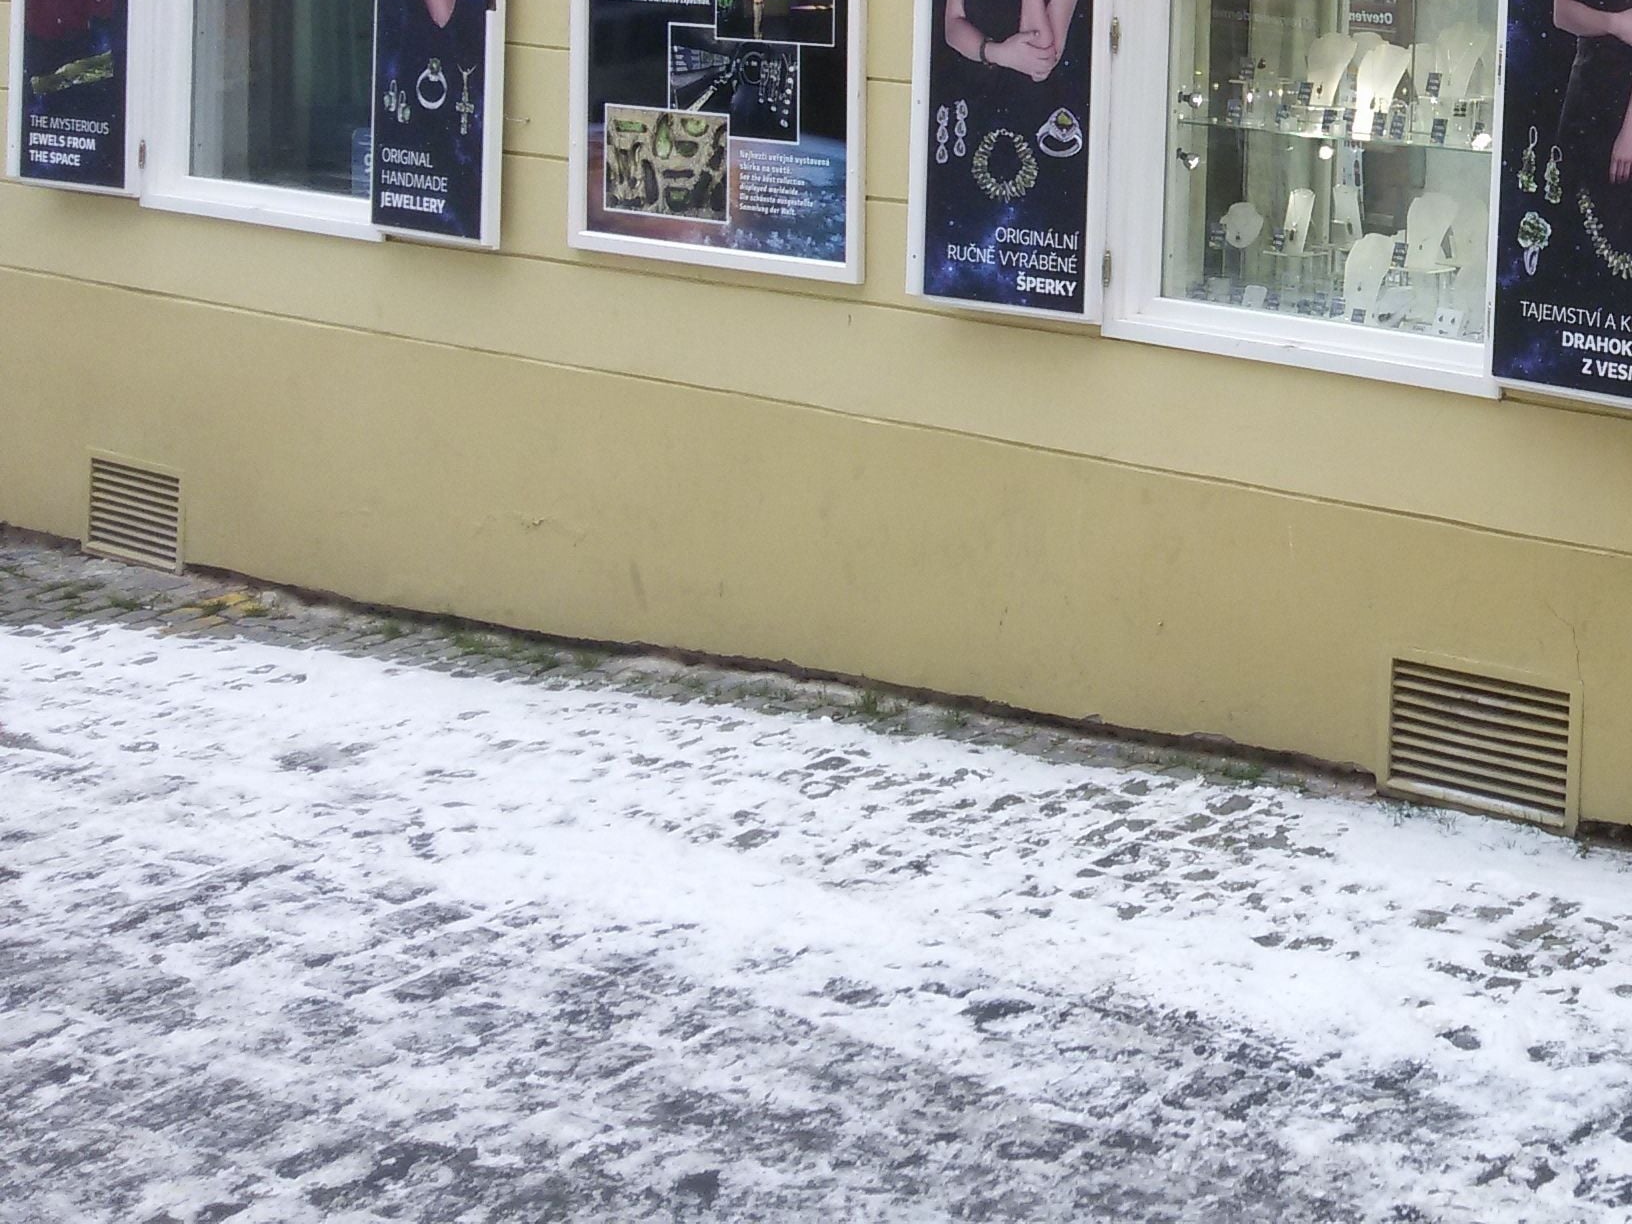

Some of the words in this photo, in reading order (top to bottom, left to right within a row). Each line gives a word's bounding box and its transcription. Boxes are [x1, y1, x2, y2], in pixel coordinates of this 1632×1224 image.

[30, 115, 48, 128] THE
[50, 117, 109, 135] MYSTERIOUS
[29, 132, 65, 147] JEWELS
[67, 136, 96, 151] FROM
[29, 150, 48, 163] THE
[49, 152, 80, 166] SPACE
[382, 147, 433, 168] ORIGINAL
[381, 169, 448, 192] HANDMADE
[380, 191, 446, 214] JEWELLERY
[995, 226, 1080, 251] ORIGINÁLNÍ
[947, 242, 996, 264] RUČNĚ
[999, 249, 1078, 274] VYRÁBĚNÉ
[1016, 271, 1077, 297] ŠPERKY
[1520, 300, 1603, 328] TAJEMSTVÍ
[1604, 313, 1617, 330] A
[1581, 358, 1593, 375] Z
